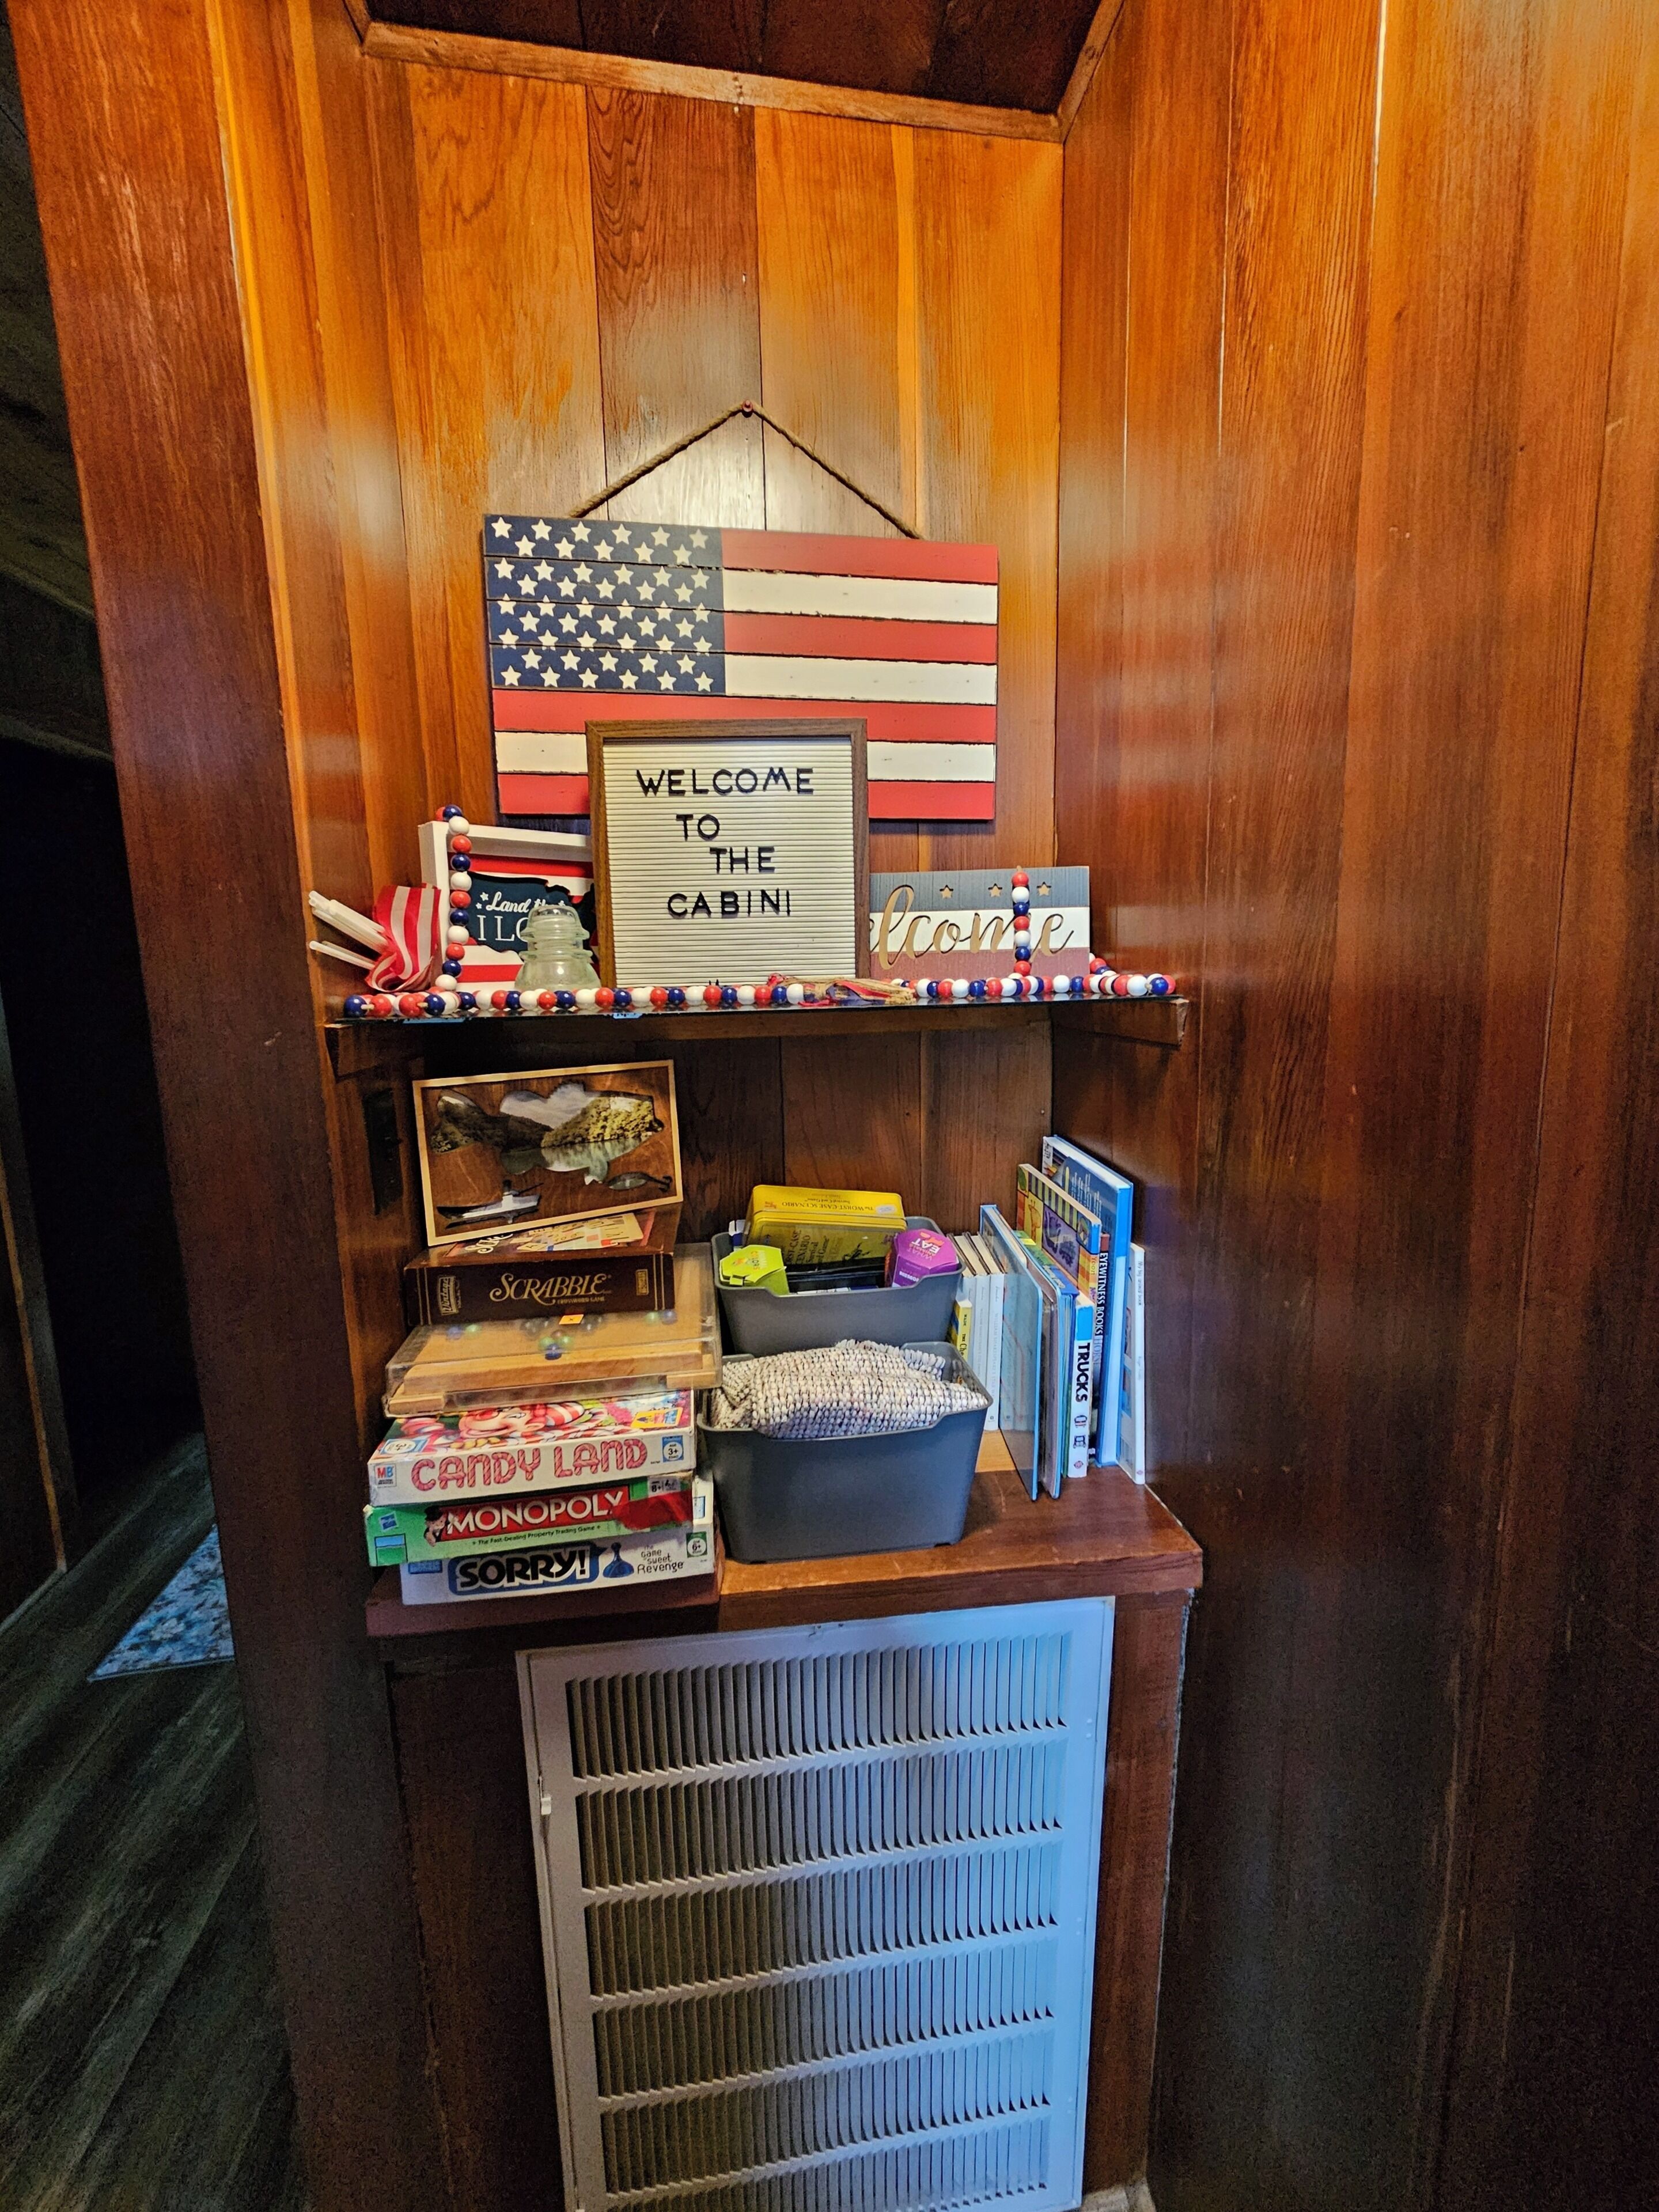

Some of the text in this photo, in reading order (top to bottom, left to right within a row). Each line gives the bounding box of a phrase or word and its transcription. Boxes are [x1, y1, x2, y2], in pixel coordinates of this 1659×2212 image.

[636, 767, 815, 796] WELCOME
[676, 813, 720, 841] TO
[710, 846, 775, 874] THE
[486, 891, 532, 913] Land
[476, 915, 487, 941] I
[911, 1238, 941, 1255] EAT
[489, 1272, 607, 1306] SCRABBLE
[1097, 1252, 1108, 1304] EYEWITNESS
[442, 1276, 452, 1312] Vintage
[1095, 1306, 1105, 1335] BOOKS
[1075, 1343, 1090, 1402] TRUCKS
[411, 1438, 648, 1492] CANDY LAND
[668, 1448, 679, 1456] 3+
[377, 1466, 393, 1478] MB
[652, 1484, 661, 1493] 8+
[446, 1491, 624, 1536] MONOPOLY
[490, 1535, 527, 1544] Fast-Dealing
[528, 1531, 554, 1540] Property
[459, 1546, 589, 1590] SORRY!
[637, 1561, 685, 1575] Revenge
[647, 1552, 672, 1565] sweet
